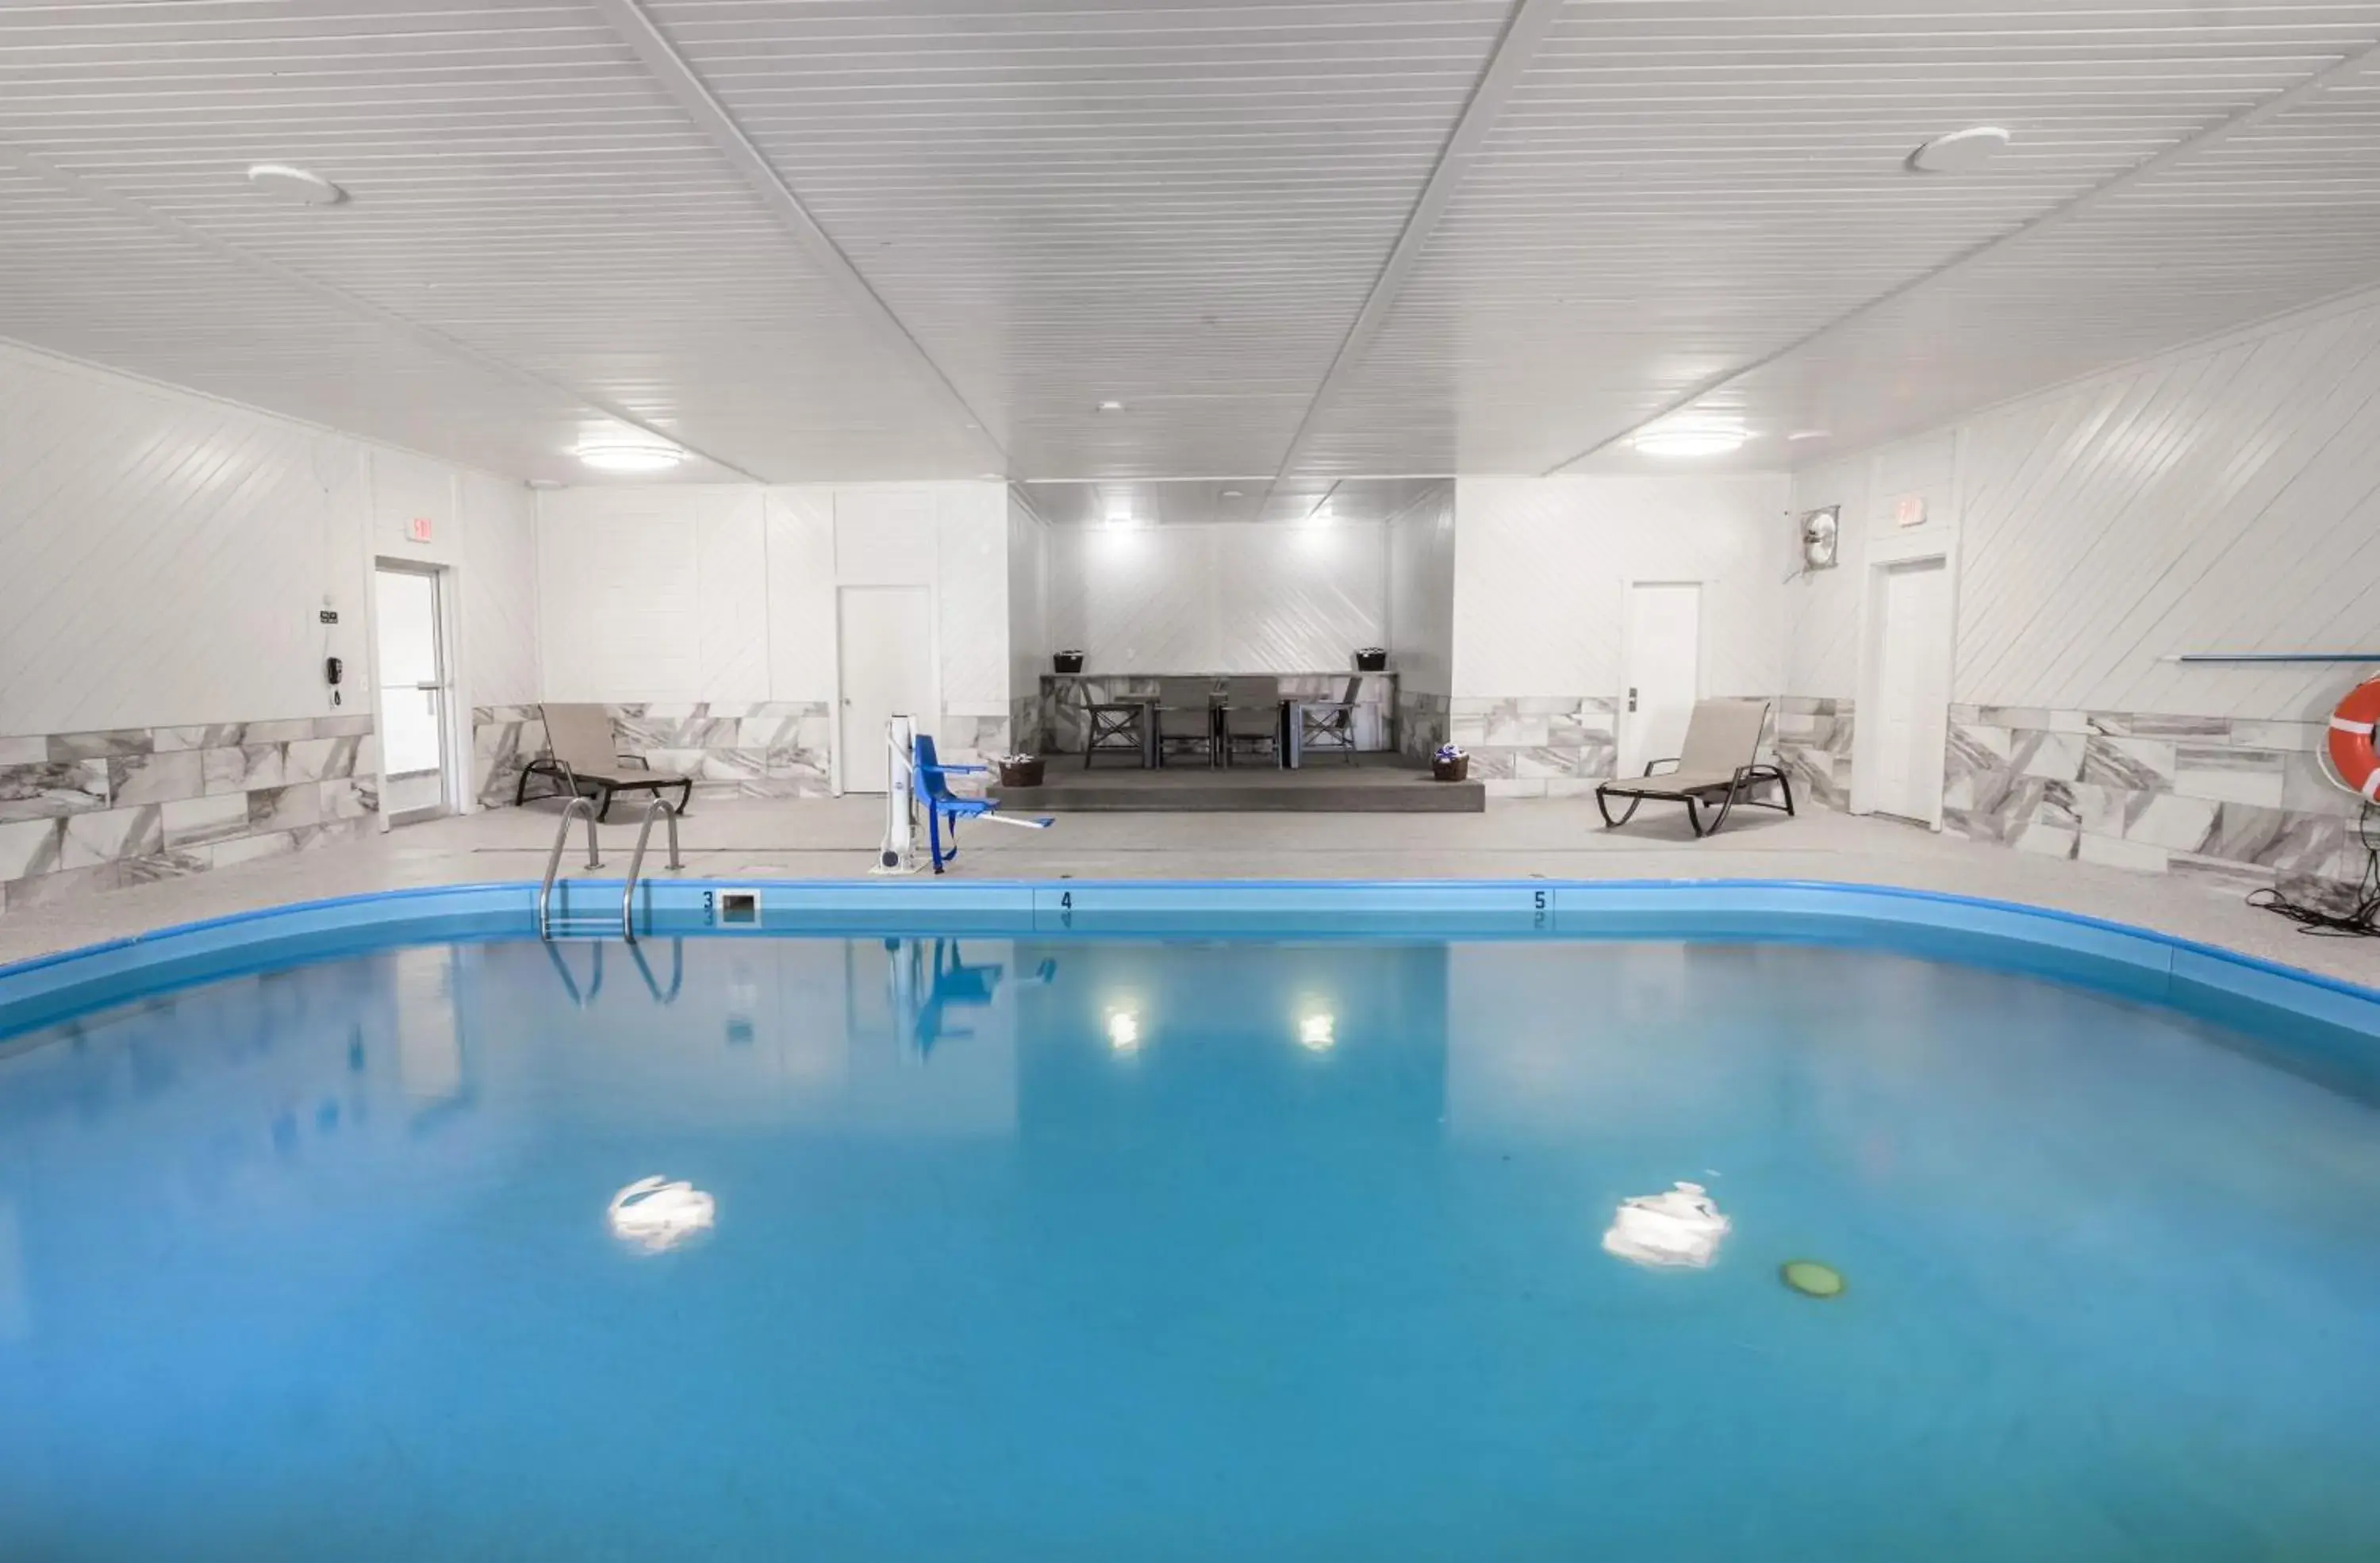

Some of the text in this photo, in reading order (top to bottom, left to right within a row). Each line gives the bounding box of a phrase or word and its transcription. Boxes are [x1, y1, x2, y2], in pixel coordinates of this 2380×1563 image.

[704, 891, 713, 908] 3
[1061, 891, 1072, 909] 4
[1535, 891, 1545, 908] 5
